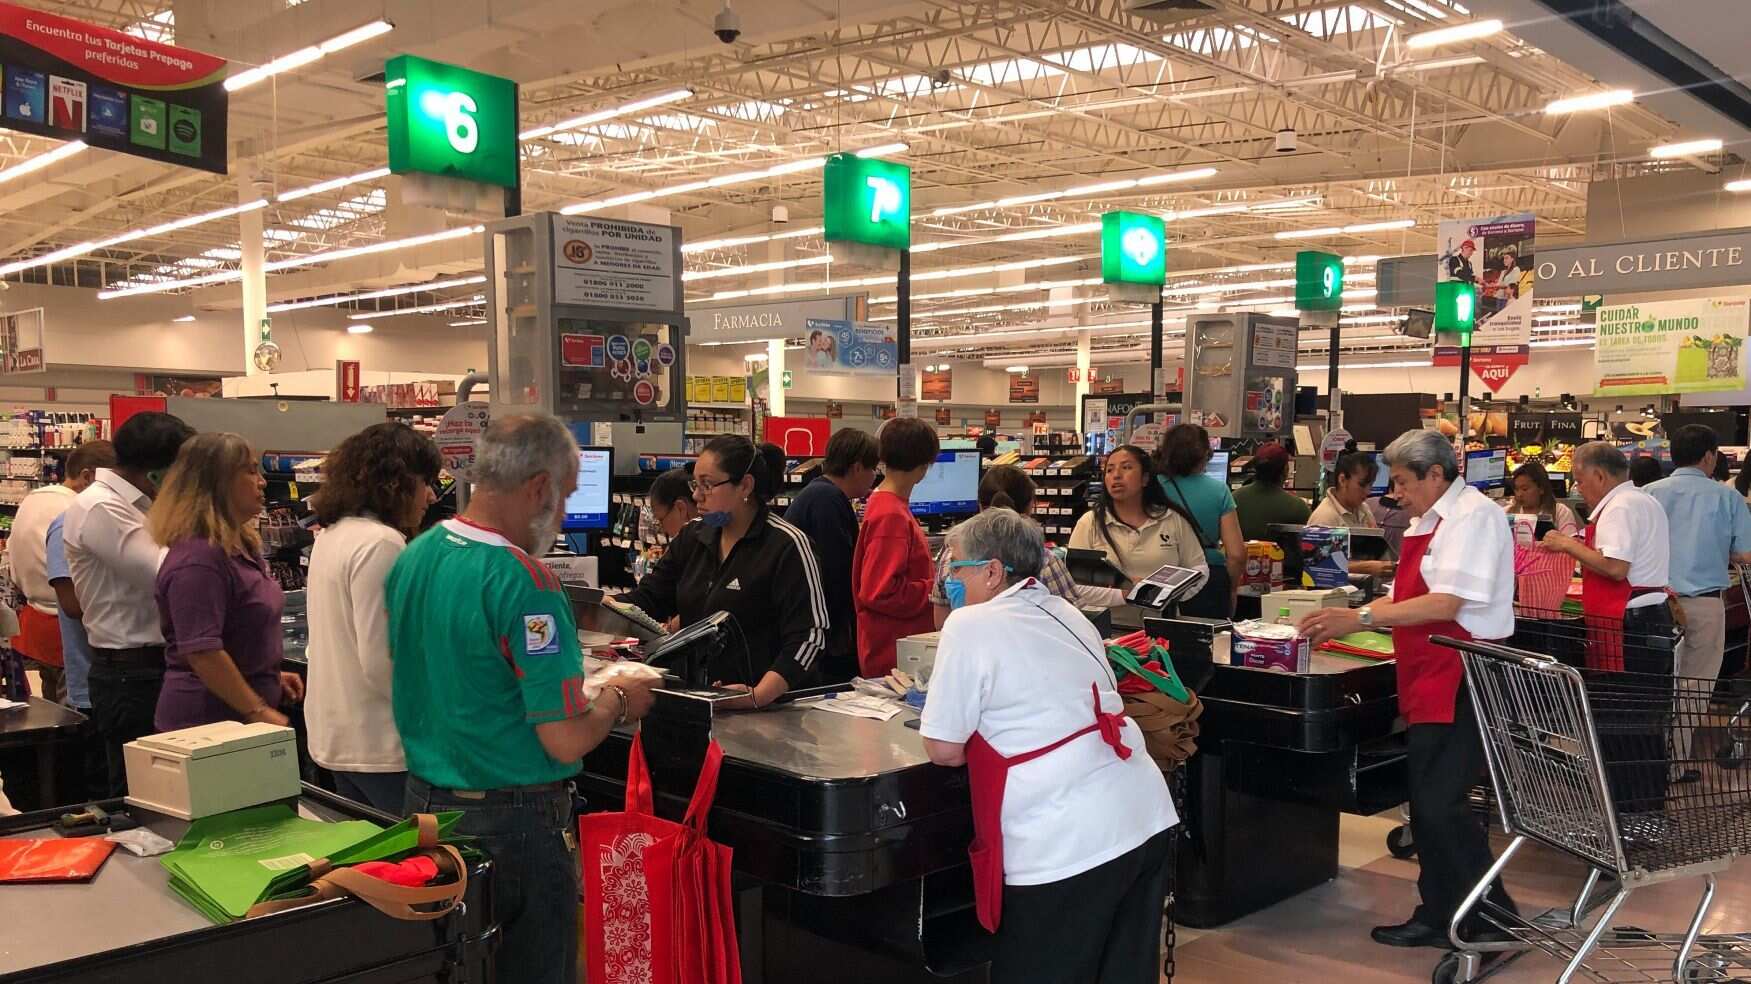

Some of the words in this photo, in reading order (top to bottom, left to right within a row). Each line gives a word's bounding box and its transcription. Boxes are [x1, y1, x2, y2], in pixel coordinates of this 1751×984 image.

[26, 19, 82, 42] Encuentra
[85, 33, 103, 47] tus
[104, 38, 149, 59] Tarjetas
[149, 50, 193, 71] Prepago
[85, 49, 139, 70] preferidas
[53, 84, 83, 98] NETFLIX
[446, 92, 478, 153] 6
[866, 176, 890, 223] 7
[590, 222, 644, 235] PROHIBIDA
[601, 230, 622, 239] POR
[624, 233, 663, 243] UNIDAD
[1567, 258, 1604, 278] AL
[1615, 247, 1743, 275] CLIENTE
[1323, 266, 1334, 298] 9
[714, 312, 783, 331] FARMACIA
[1600, 306, 1639, 322] CUIDAR
[1657, 316, 1699, 332] MUNDO
[1481, 365, 1509, 381] AQUÍ
[1514, 419, 1541, 430] FRUT
[1551, 419, 1577, 430] FINA
